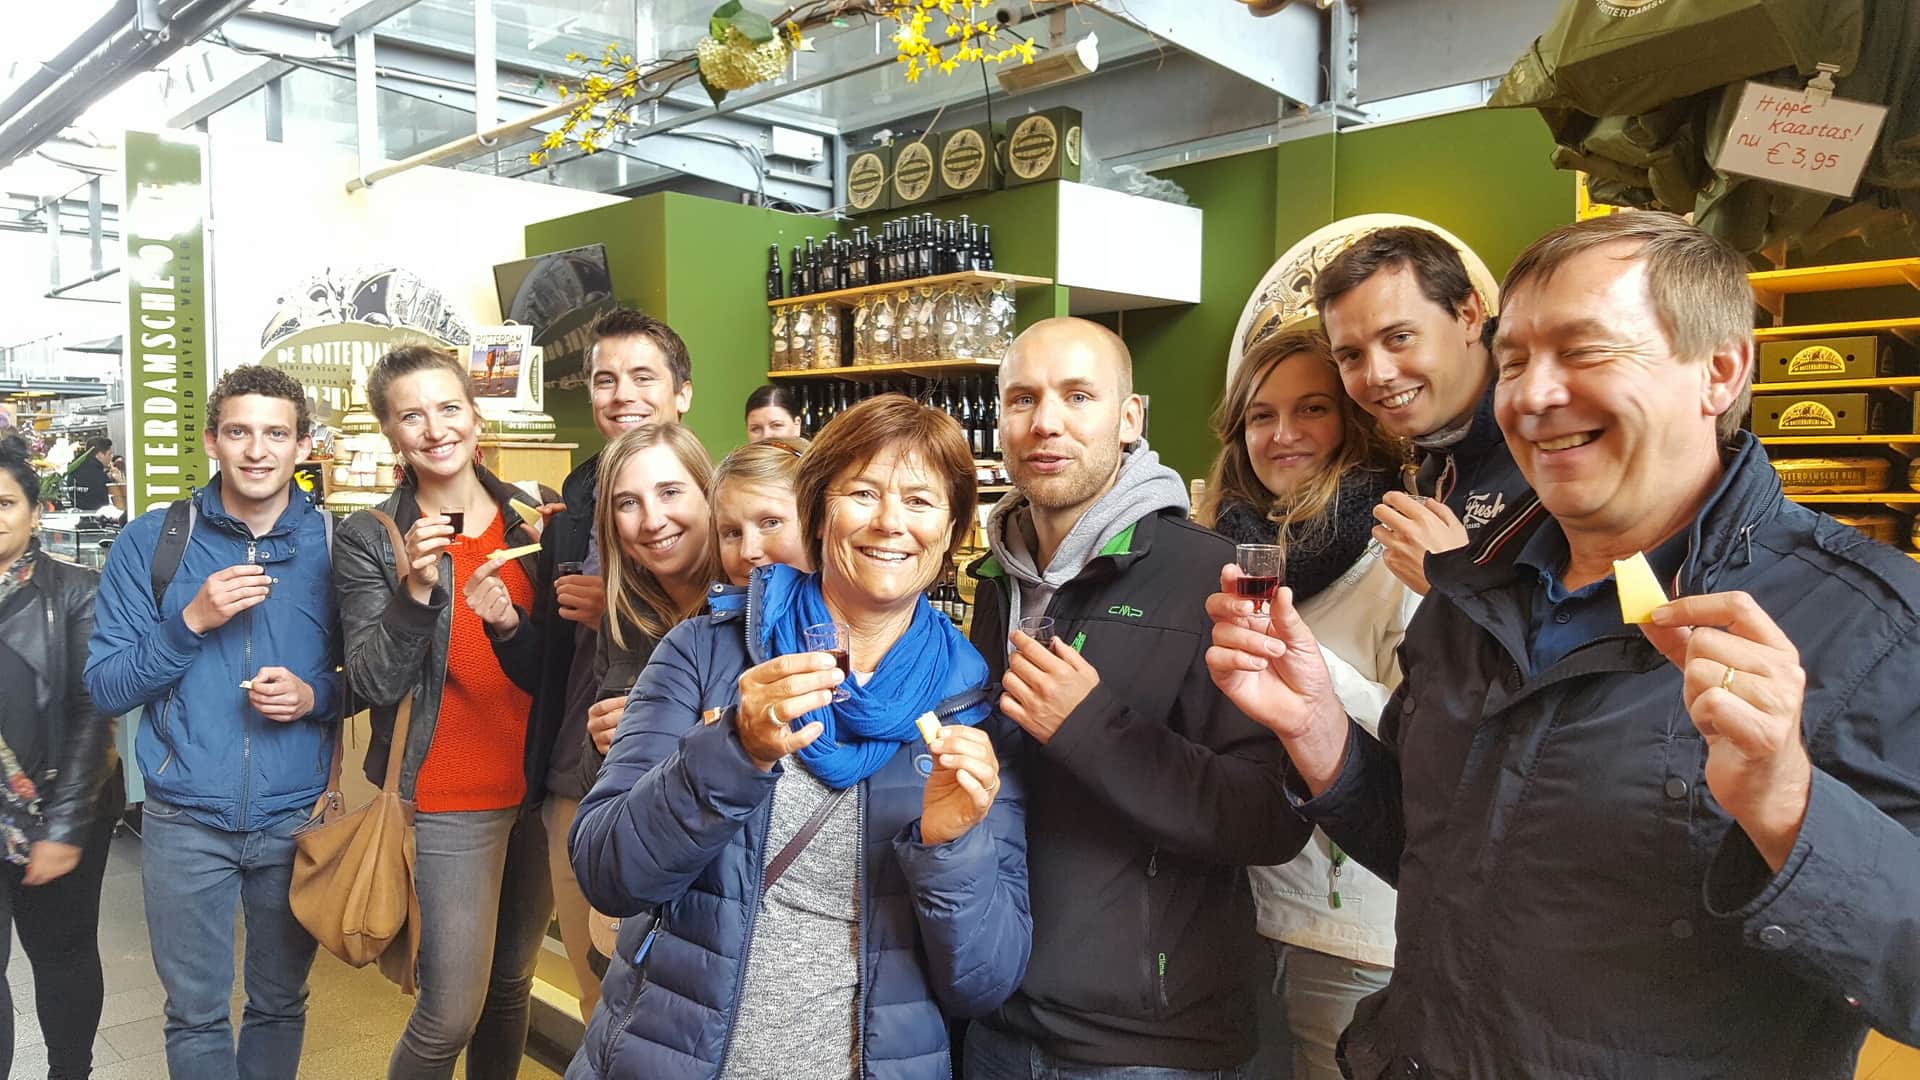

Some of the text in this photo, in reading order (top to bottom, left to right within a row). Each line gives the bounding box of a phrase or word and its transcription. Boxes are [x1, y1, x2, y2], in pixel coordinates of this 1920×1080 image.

[1755, 94, 1813, 118] Hippe
[1737, 133, 1761, 147] nu
[1792, 147, 1839, 171] 3,95
[182, 316, 193, 379] HAVEN,
[277, 346, 296, 363] DE
[183, 390, 195, 454] WERELD
[1463, 492, 1505, 525] Fresh
[1108, 604, 1144, 617] CMP
